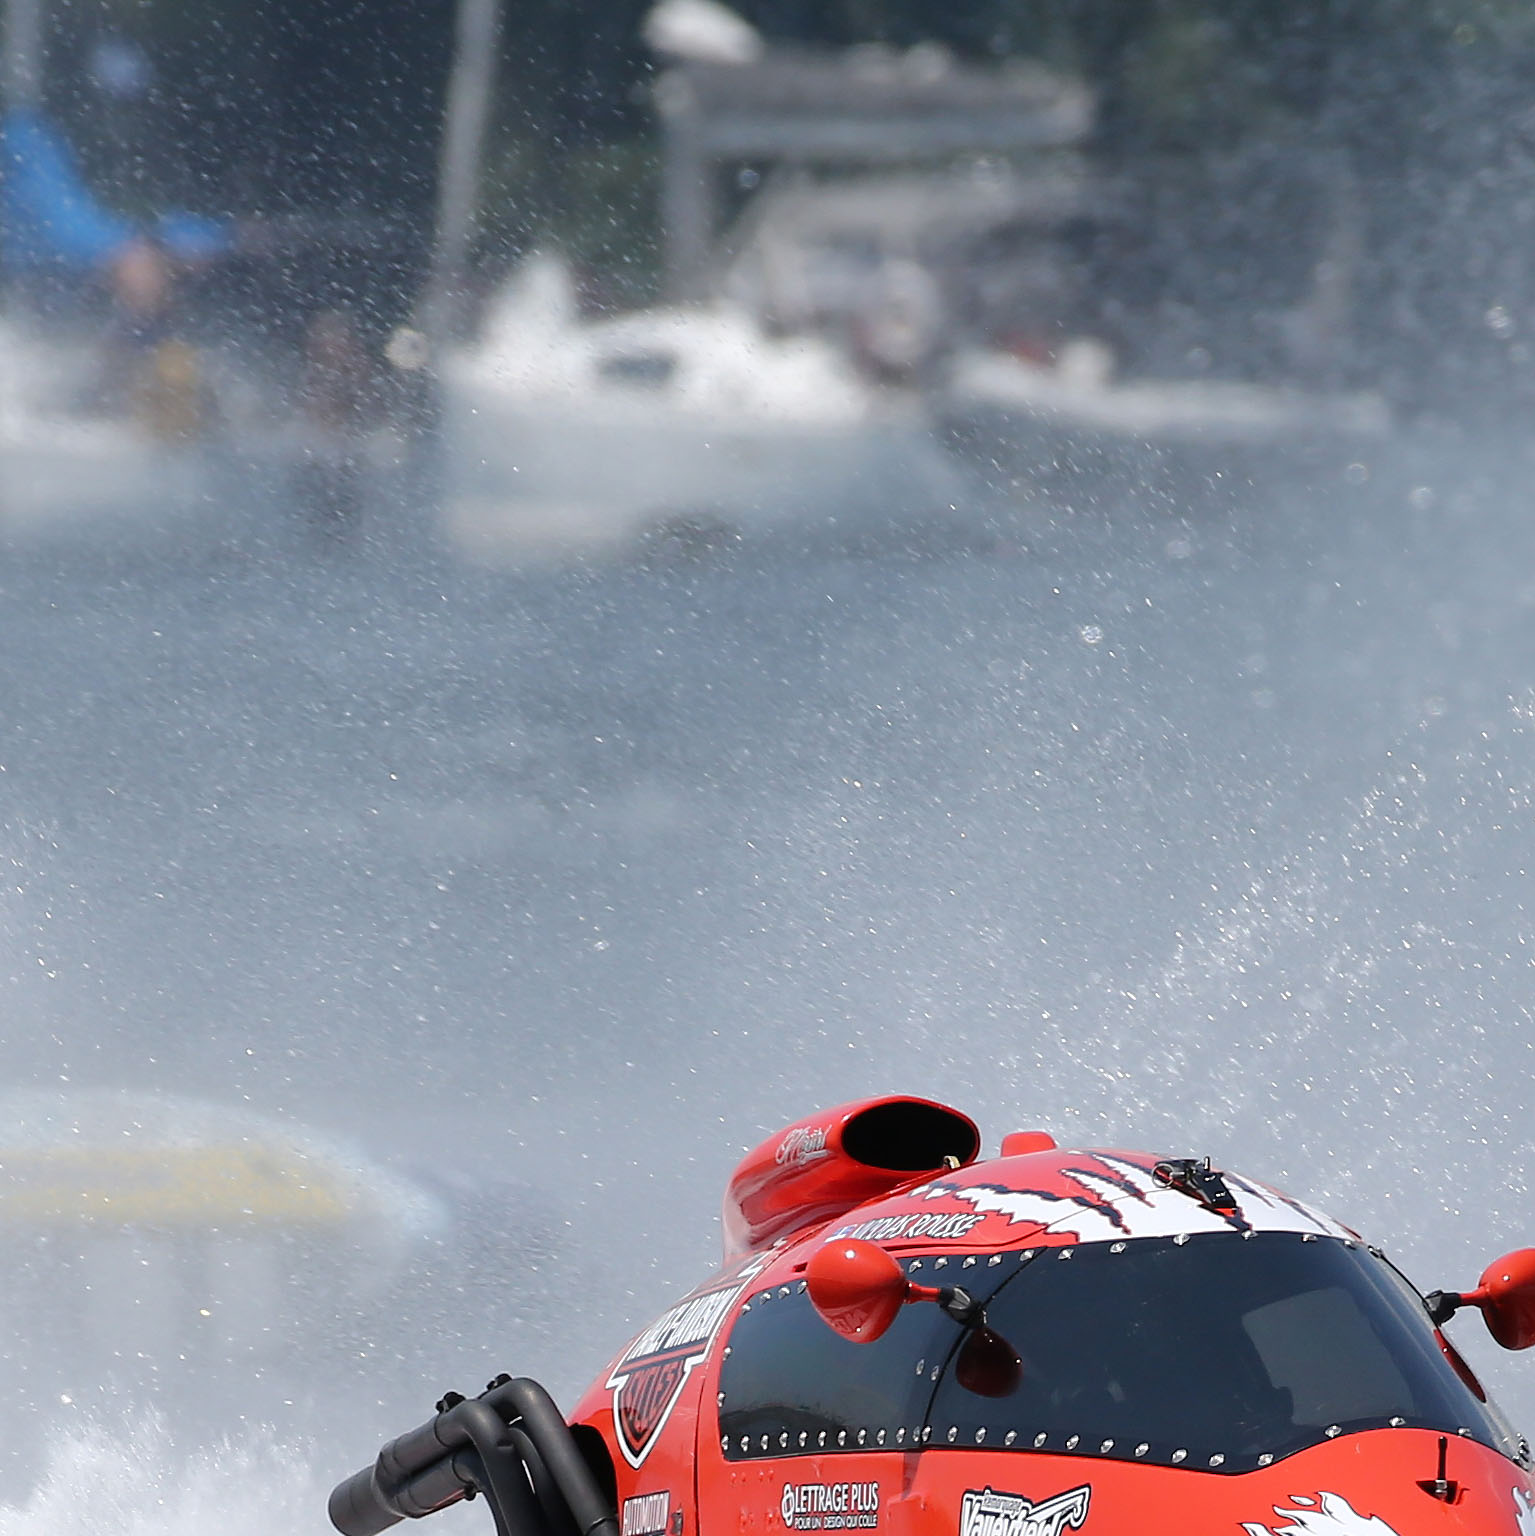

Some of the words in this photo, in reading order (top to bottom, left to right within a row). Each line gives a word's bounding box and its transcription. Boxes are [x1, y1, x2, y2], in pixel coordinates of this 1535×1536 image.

[904, 1213, 987, 1239] ROUSSE
[795, 1484, 849, 1513] LETTRAGE
[850, 1482, 878, 1512] PLUS
[794, 1516, 811, 1529] POUR
[811, 1516, 822, 1529] UN
[823, 1515, 845, 1529] DESIGN
[846, 1515, 857, 1528] QUI
[858, 1514, 877, 1527] COLLE
